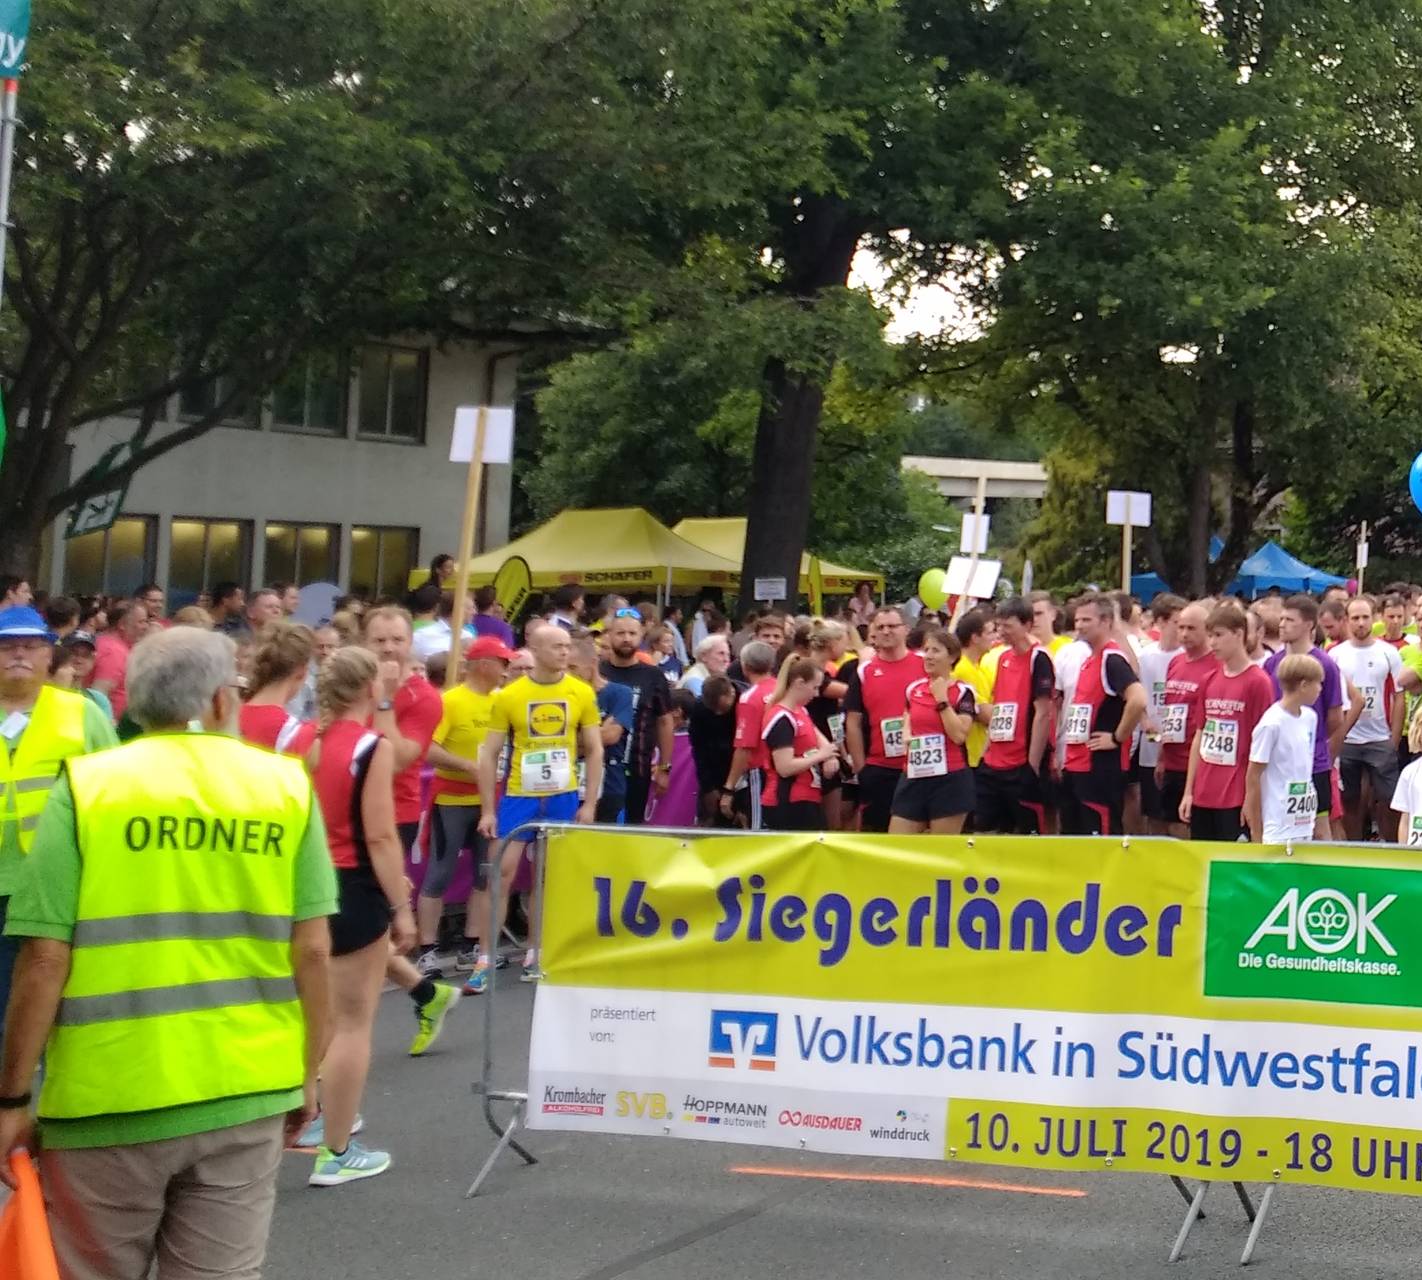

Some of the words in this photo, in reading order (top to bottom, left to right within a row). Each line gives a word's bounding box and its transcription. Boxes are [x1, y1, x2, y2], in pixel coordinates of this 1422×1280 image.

[0, 32, 26, 68] y
[1203, 732, 1234, 753] 7248
[541, 764, 552, 781] 5
[125, 815, 285, 858] ORDNER
[593, 876, 689, 940] 16.
[713, 874, 1182, 967] Siegerländer
[1244, 887, 1399, 957] AOK
[1238, 952, 1263, 969] Die
[1265, 953, 1402, 976] Gesundheitskasse.
[590, 1006, 656, 1025] präsentiert
[589, 1031, 615, 1043] von:
[795, 1014, 1037, 1076] Volksbank
[1053, 1026, 1095, 1079] in
[543, 1086, 606, 1105] Krombacher
[682, 1094, 768, 1116] HOPPMANN
[802, 1113, 862, 1132] AUSDAUER
[869, 1127, 930, 1142] winddruck
[966, 1112, 1020, 1153] 10.
[1034, 1116, 1127, 1158] JULI
[1146, 1121, 1242, 1168] 2019
[1284, 1132, 1333, 1172] 18
